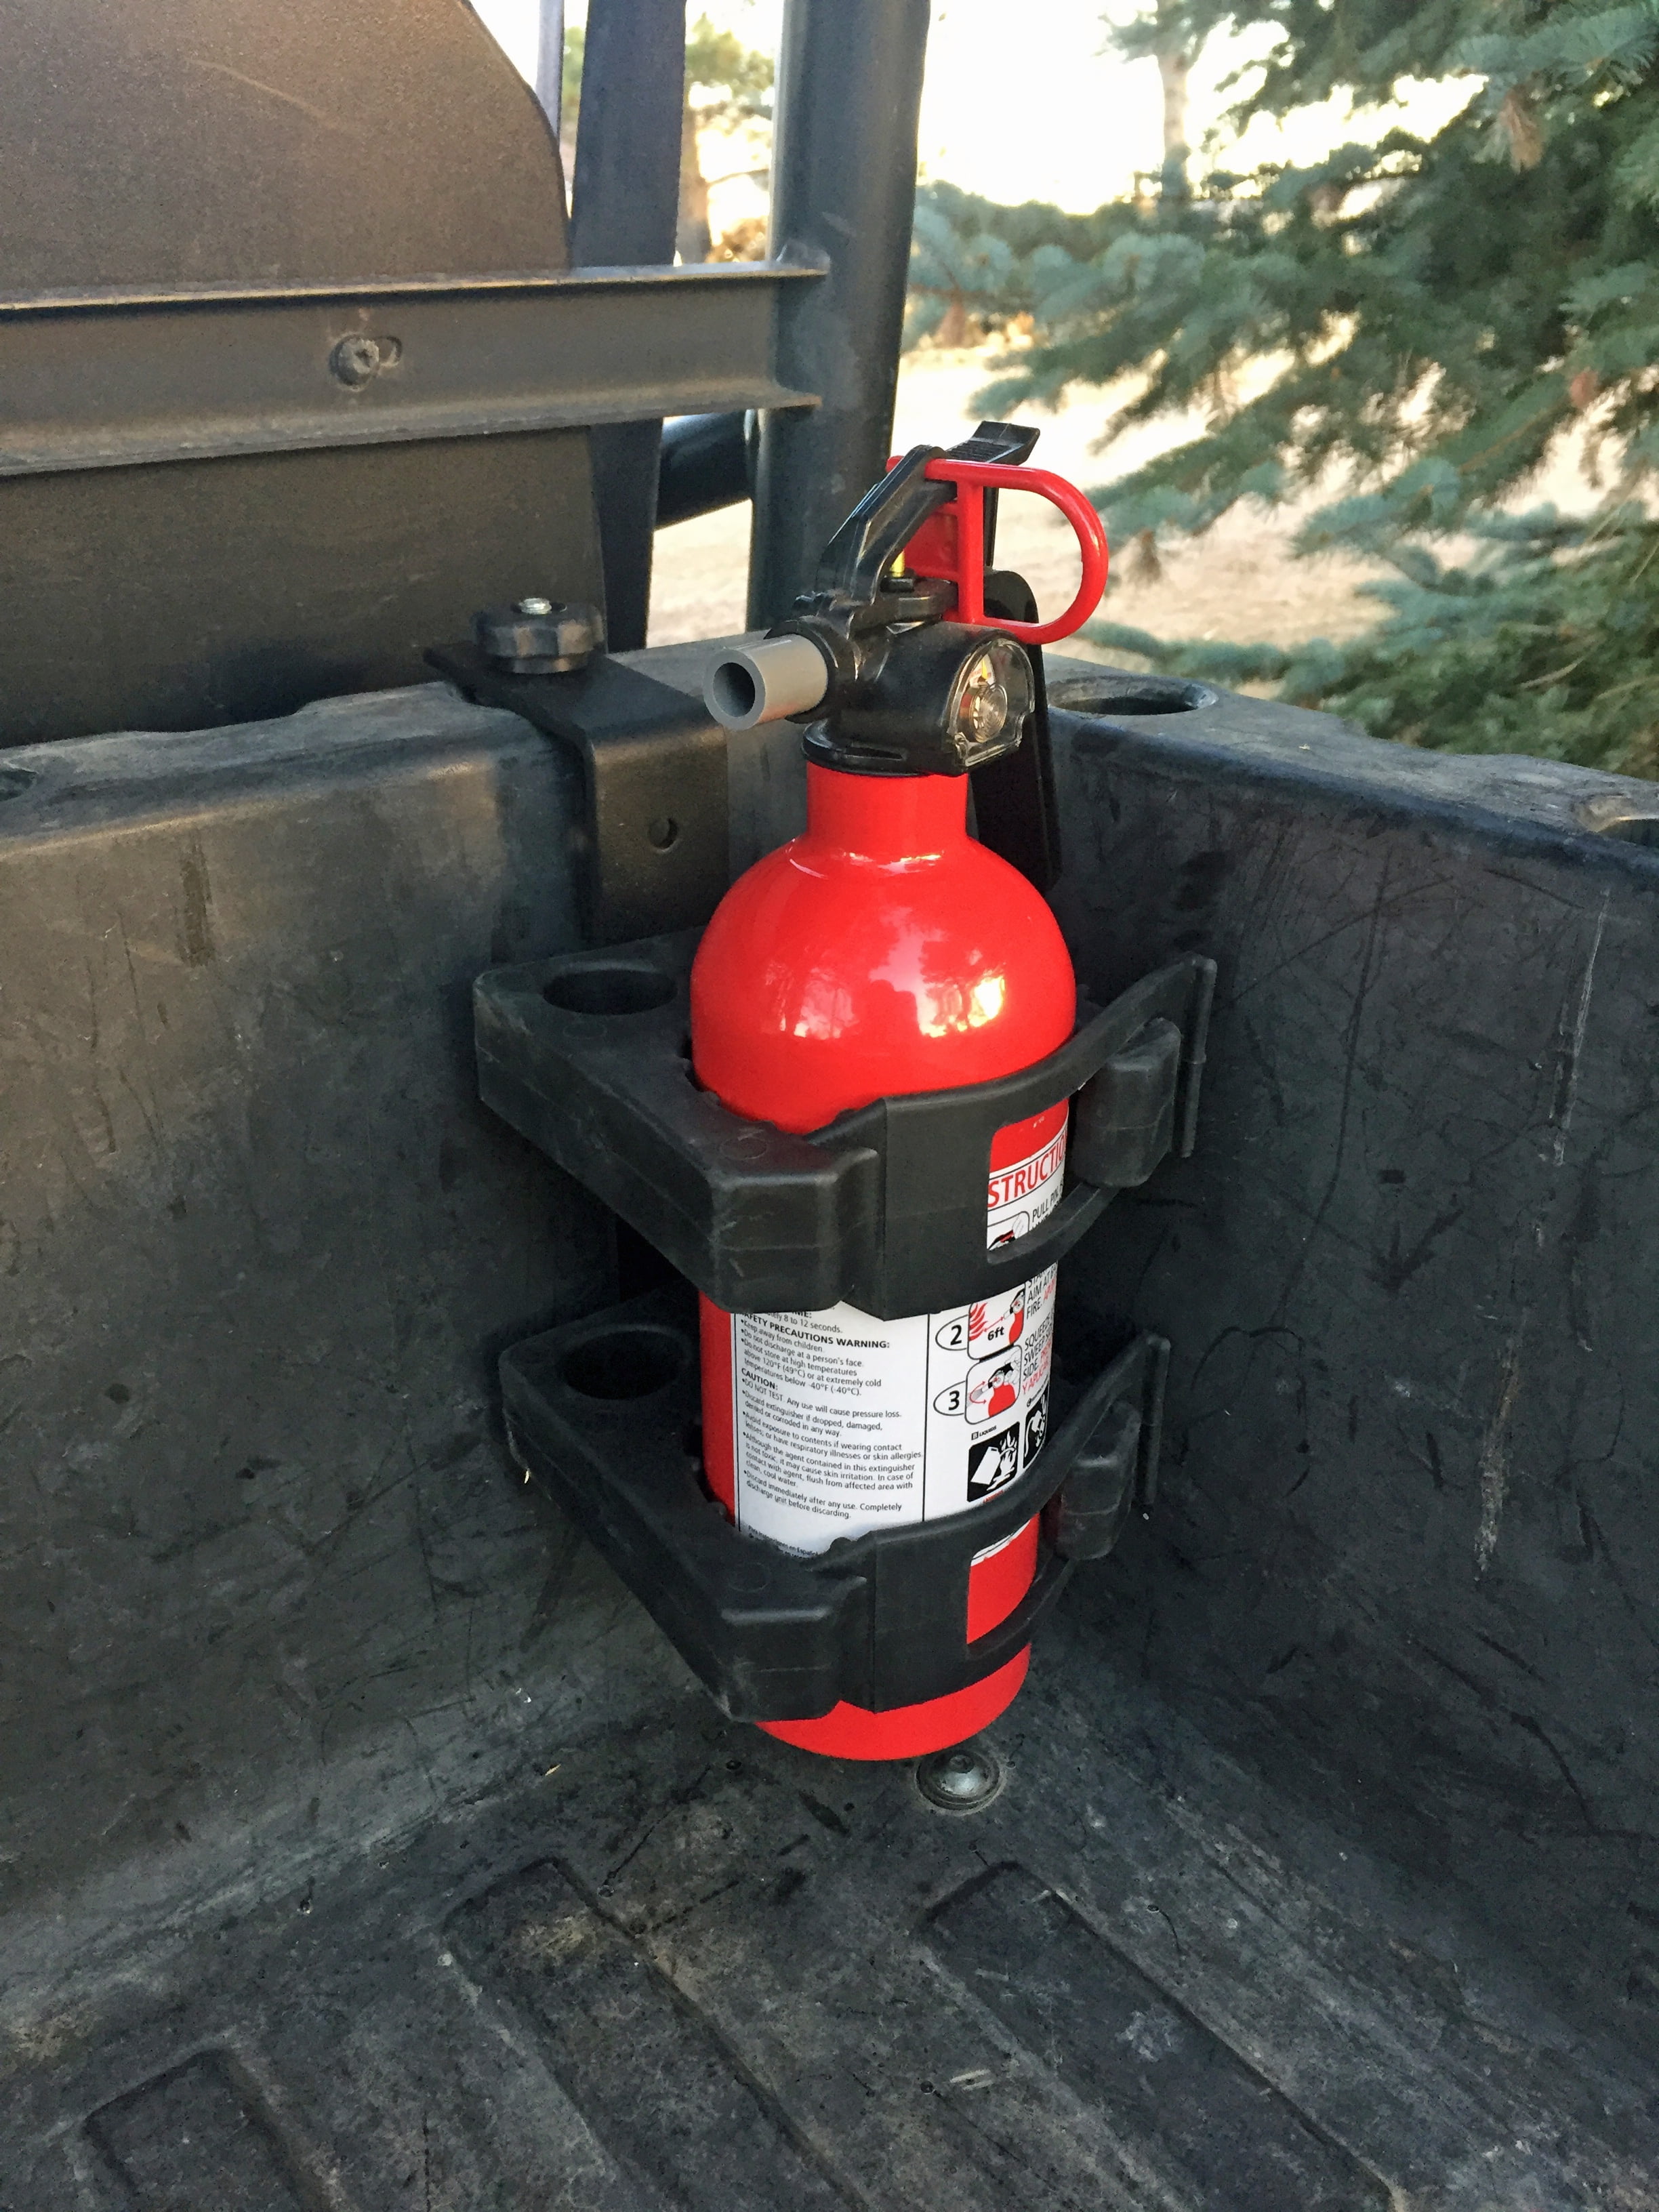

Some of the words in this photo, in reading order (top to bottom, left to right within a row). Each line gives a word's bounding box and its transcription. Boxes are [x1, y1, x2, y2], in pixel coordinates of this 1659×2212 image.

[1031, 1198, 1049, 1223] PULL
[1027, 1280, 1042, 1305] AIM
[741, 1313, 768, 1327] AFETY
[769, 1322, 834, 1345] PRECAUTIONS
[836, 1338, 890, 1349] WARNING:
[784, 1314, 788, 1322] 8
[800, 1319, 808, 1327] 12
[810, 1323, 842, 1334] seconds.
[950, 1324, 962, 1346] 2
[987, 1326, 1004, 1341] 6ft
[743, 1329, 752, 1338] Do
[753, 1334, 763, 1344] not
[764, 1338, 796, 1356] discharge
[813, 1355, 844, 1365] person's
[777, 1334, 792, 1345] from
[743, 1338, 752, 1347] Do
[753, 1343, 763, 1354] not
[764, 1349, 780, 1359] store
[790, 1357, 806, 1368] high
[808, 1363, 857, 1376] temperatures
[744, 1349, 761, 1362] above
[826, 1376, 863, 1387] extremely
[865, 1379, 882, 1387] cold
[741, 1368, 778, 1391] CAUTION:
[785, 1376, 806, 1387] below
[745, 1378, 754, 1389] DO
[754, 1384, 766, 1395] NOT
[787, 1397, 800, 1408] Any
[801, 1402, 813, 1410] use
[815, 1405, 827, 1413] will
[853, 1410, 883, 1418] pressure
[885, 1410, 902, 1418] loss.
[948, 1391, 960, 1410] 3
[766, 1402, 804, 1420] extinguisher
[813, 1416, 844, 1428] dropped,
[846, 1421, 883, 1431] damaged,
[773, 1414, 800, 1429] corroded
[811, 1427, 823, 1435] any
[825, 1429, 841, 1437] way.
[762, 1422, 791, 1437] exposure
[801, 1435, 832, 1447] contents
[841, 1443, 872, 1452] wearing
[773, 1435, 788, 1446] have
[790, 1441, 828, 1457] respiratory
[830, 1450, 861, 1459] illnesses
[873, 1452, 888, 1460] skin
[746, 1433, 772, 1451] Although
[773, 1446, 784, 1456] the
[785, 1452, 804, 1462] agent
[806, 1457, 842, 1469] contained
[853, 1464, 867, 1472] this
[869, 1464, 915, 1473] extinguisher
[751, 1445, 762, 1455] not
[785, 1461, 800, 1471] may
[802, 1466, 822, 1476] cause
[823, 1470, 838, 1478] skin
[905, 1471, 914, 1479] of
[764, 1469, 777, 1480] cool
[768, 1462, 781, 1473] with
[783, 1469, 804, 1481] agent,
[806, 1475, 823, 1484] flush
[825, 1478, 843, 1488] from
[844, 1481, 876, 1490] affected
[896, 1481, 913, 1490] with
[768, 1481, 808, 1502] immediately
[809, 1496, 826, 1506] after
[827, 1500, 841, 1509] any
[860, 1502, 902, 1513] Completely
[788, 1498, 811, 1511] before
[812, 1506, 851, 1519] discarding.
